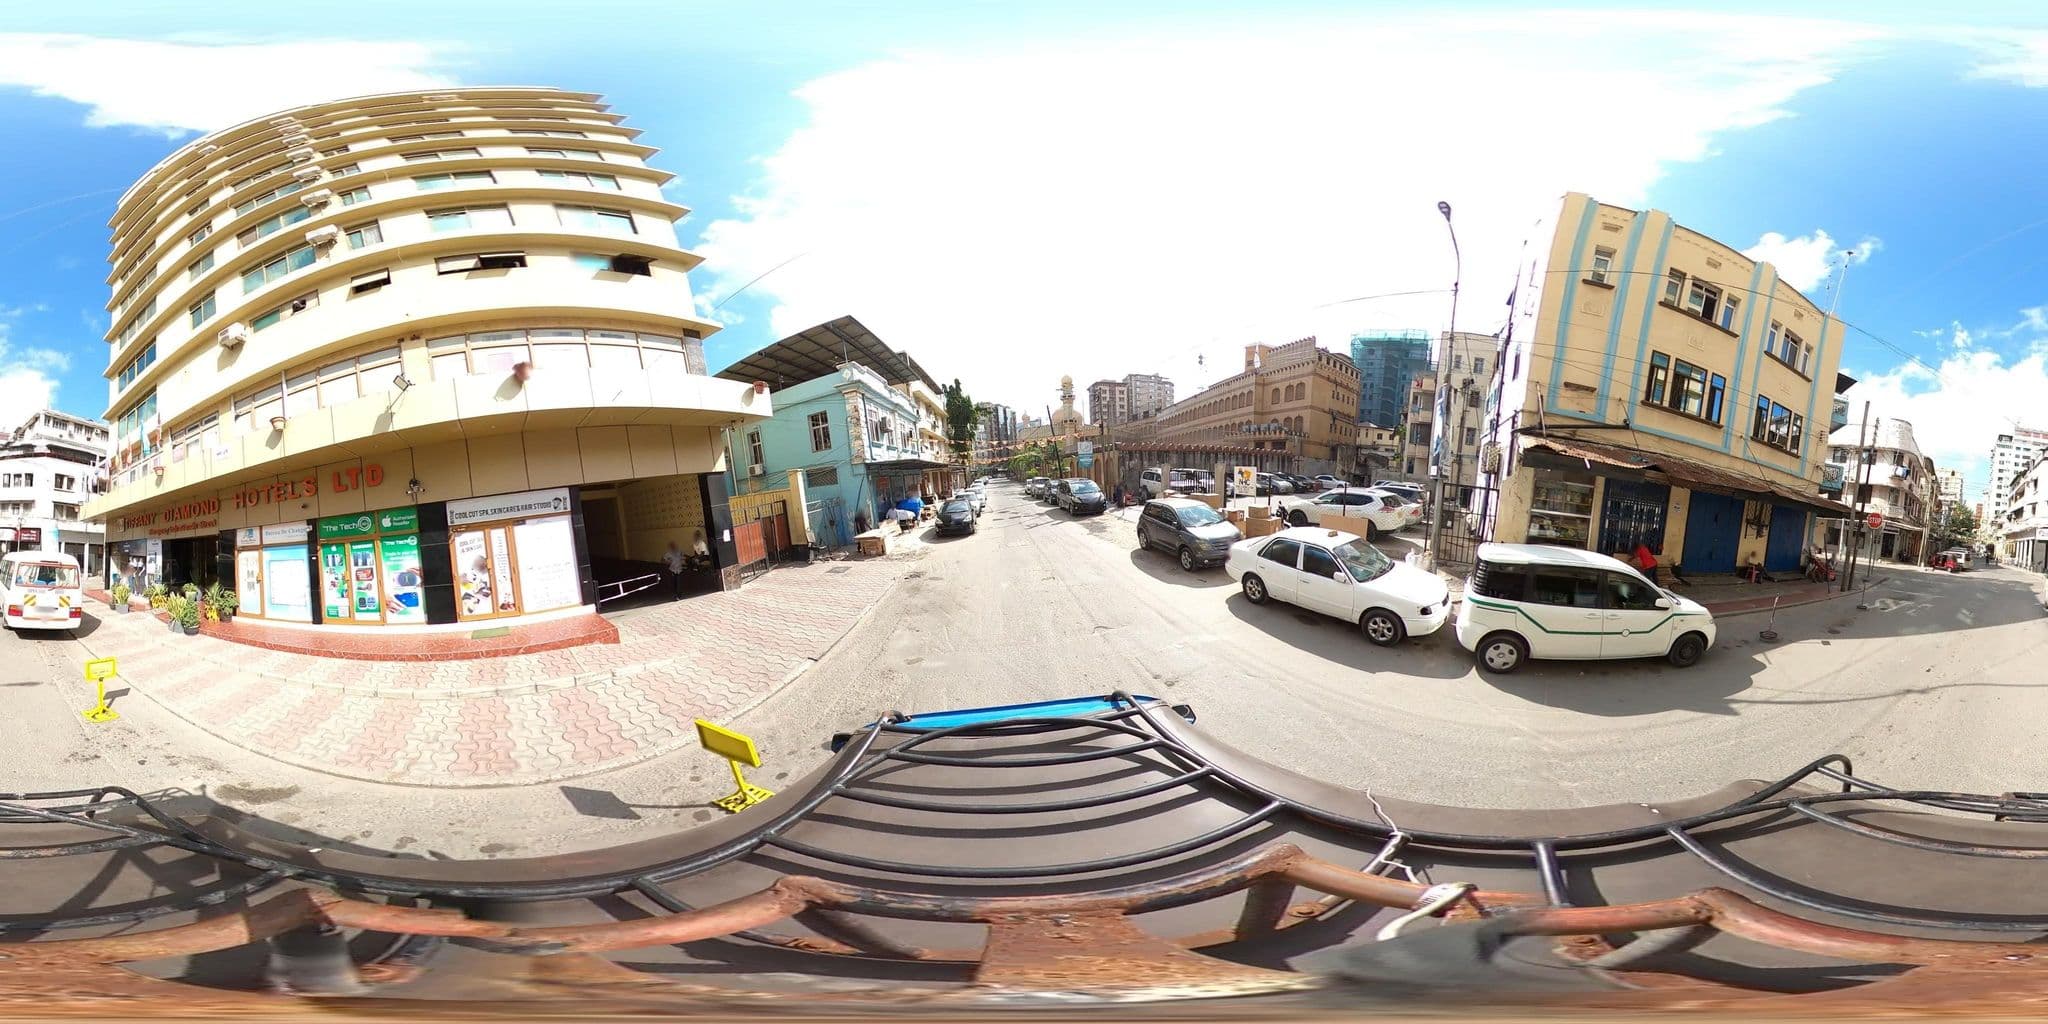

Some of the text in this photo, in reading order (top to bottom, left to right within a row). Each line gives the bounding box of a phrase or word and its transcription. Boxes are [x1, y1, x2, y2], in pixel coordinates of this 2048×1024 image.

[126, 512, 156, 529] TIFFANY
[164, 499, 220, 522] DIAMOND
[232, 475, 318, 510] HOTELS
[332, 464, 384, 493] LTD
[455, 511, 468, 520] COOL
[340, 522, 358, 530] Tech
